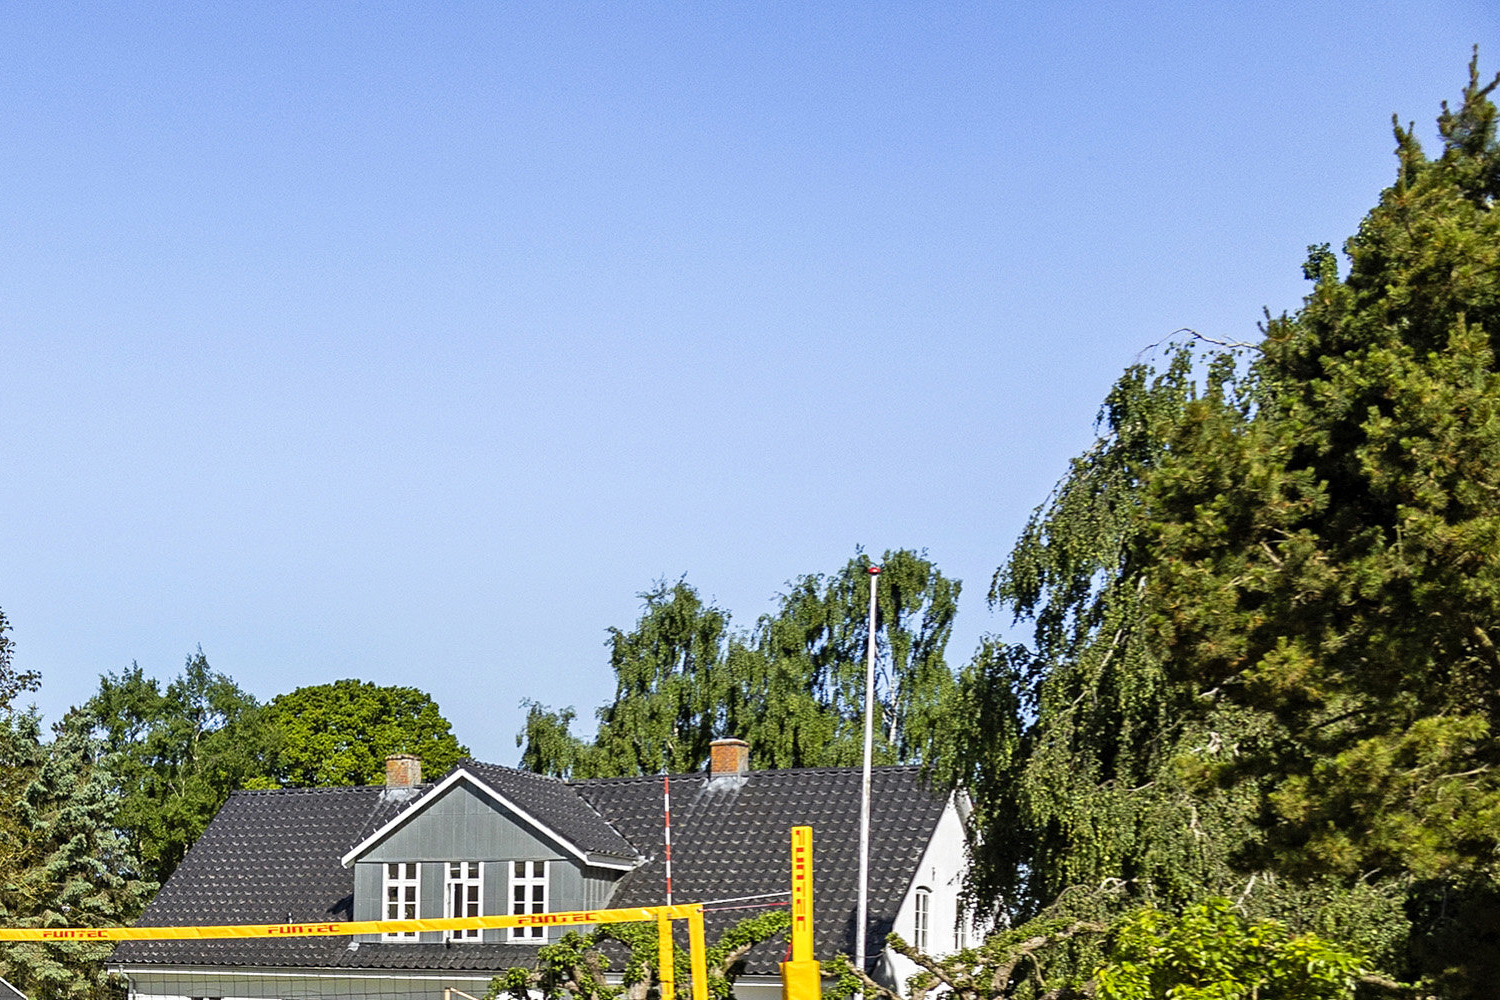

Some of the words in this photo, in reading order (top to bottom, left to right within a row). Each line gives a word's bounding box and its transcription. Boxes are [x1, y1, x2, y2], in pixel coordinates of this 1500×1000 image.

[518, 913, 596, 924] FUNTEC
[43, 930, 108, 938] FUNTEC
[268, 924, 340, 934] FUNTEC
